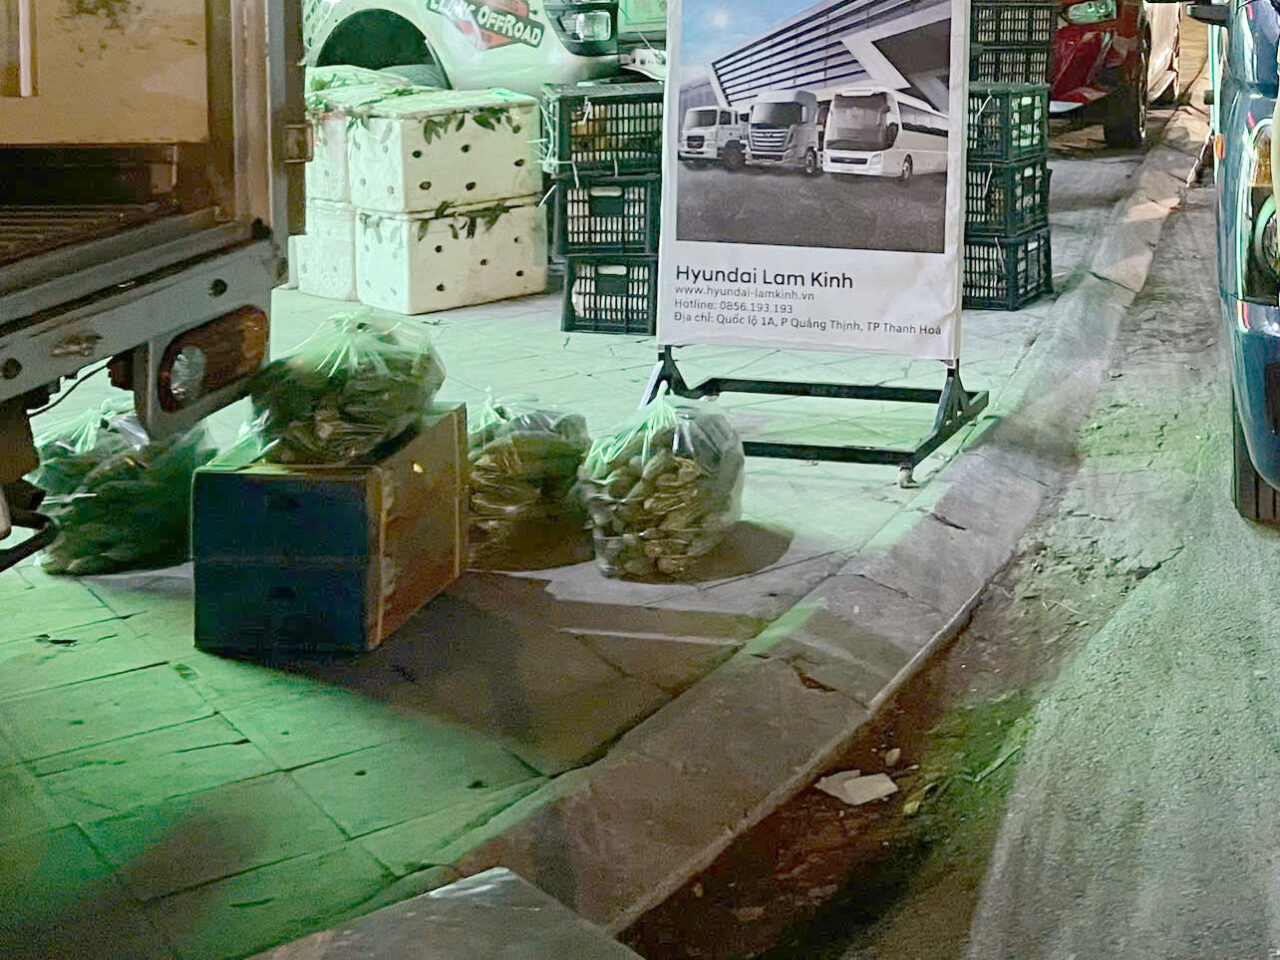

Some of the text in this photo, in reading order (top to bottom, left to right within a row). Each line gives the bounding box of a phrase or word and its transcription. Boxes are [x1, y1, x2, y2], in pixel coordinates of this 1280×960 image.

[476, 4, 542, 46] OFFROAD
[676, 265, 853, 289] Hyundai Lam Kinh
[674, 286, 815, 301] www.hyundai-lamkinh.vn
[674, 300, 793, 314] Hotline: 0856.193.193
[716, 313, 745, 325] Quốc
[790, 317, 827, 332] Quảng
[829, 320, 863, 333] Thịnh,
[866, 322, 880, 332] TP
[883, 323, 916, 335] Thanh
